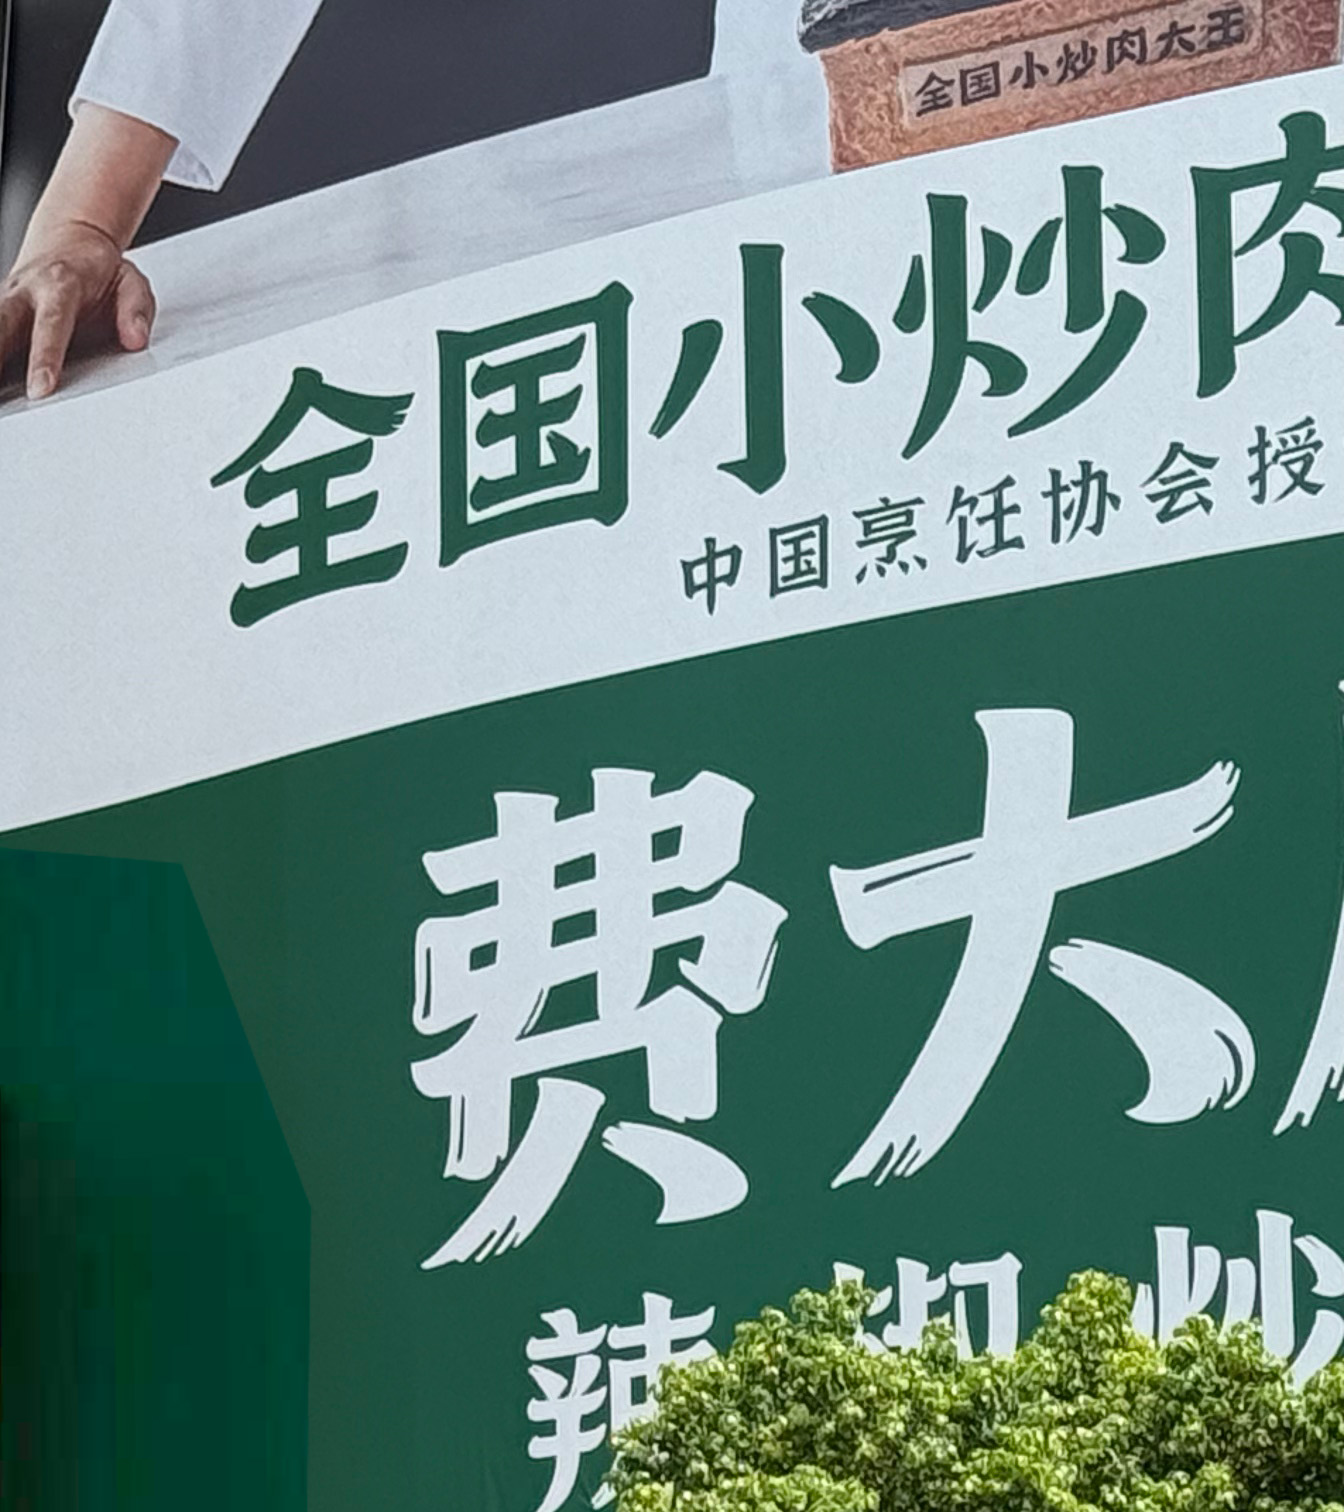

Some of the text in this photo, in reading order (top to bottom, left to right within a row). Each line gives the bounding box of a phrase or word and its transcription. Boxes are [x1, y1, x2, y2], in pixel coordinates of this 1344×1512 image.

[915, 4, 1245, 117] 全国小炒肉大王
[210, 110, 1344, 627] 全国小炒肉
[679, 416, 1324, 614] 中国烹饪协会授
[411, 708, 1344, 1269] 费大
